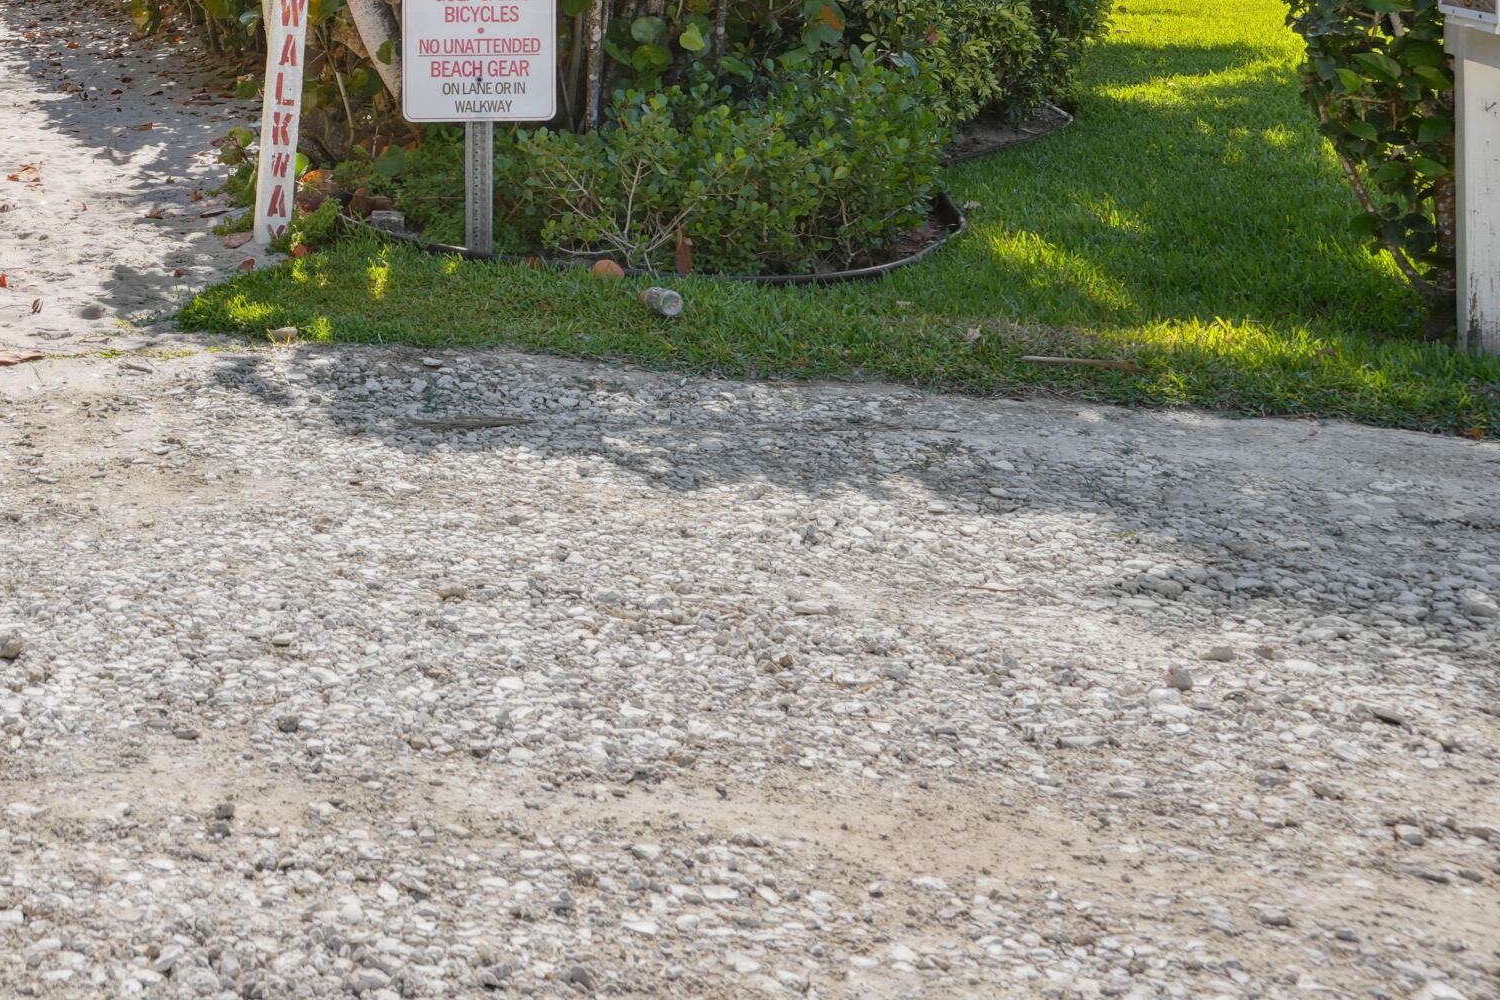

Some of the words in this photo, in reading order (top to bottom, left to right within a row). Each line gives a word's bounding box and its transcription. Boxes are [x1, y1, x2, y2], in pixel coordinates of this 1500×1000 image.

[444, 5, 519, 23] BICYCLES
[419, 39, 440, 54] NO
[443, 38, 541, 54] UNATTENDED
[430, 60, 483, 77] BEACH
[487, 60, 530, 76] GEAR
[442, 82, 460, 95] ON
[462, 82, 492, 95] LANE
[495, 82, 511, 94] OR
[514, 81, 526, 94] IN
[454, 100, 512, 113] WALKWAY
